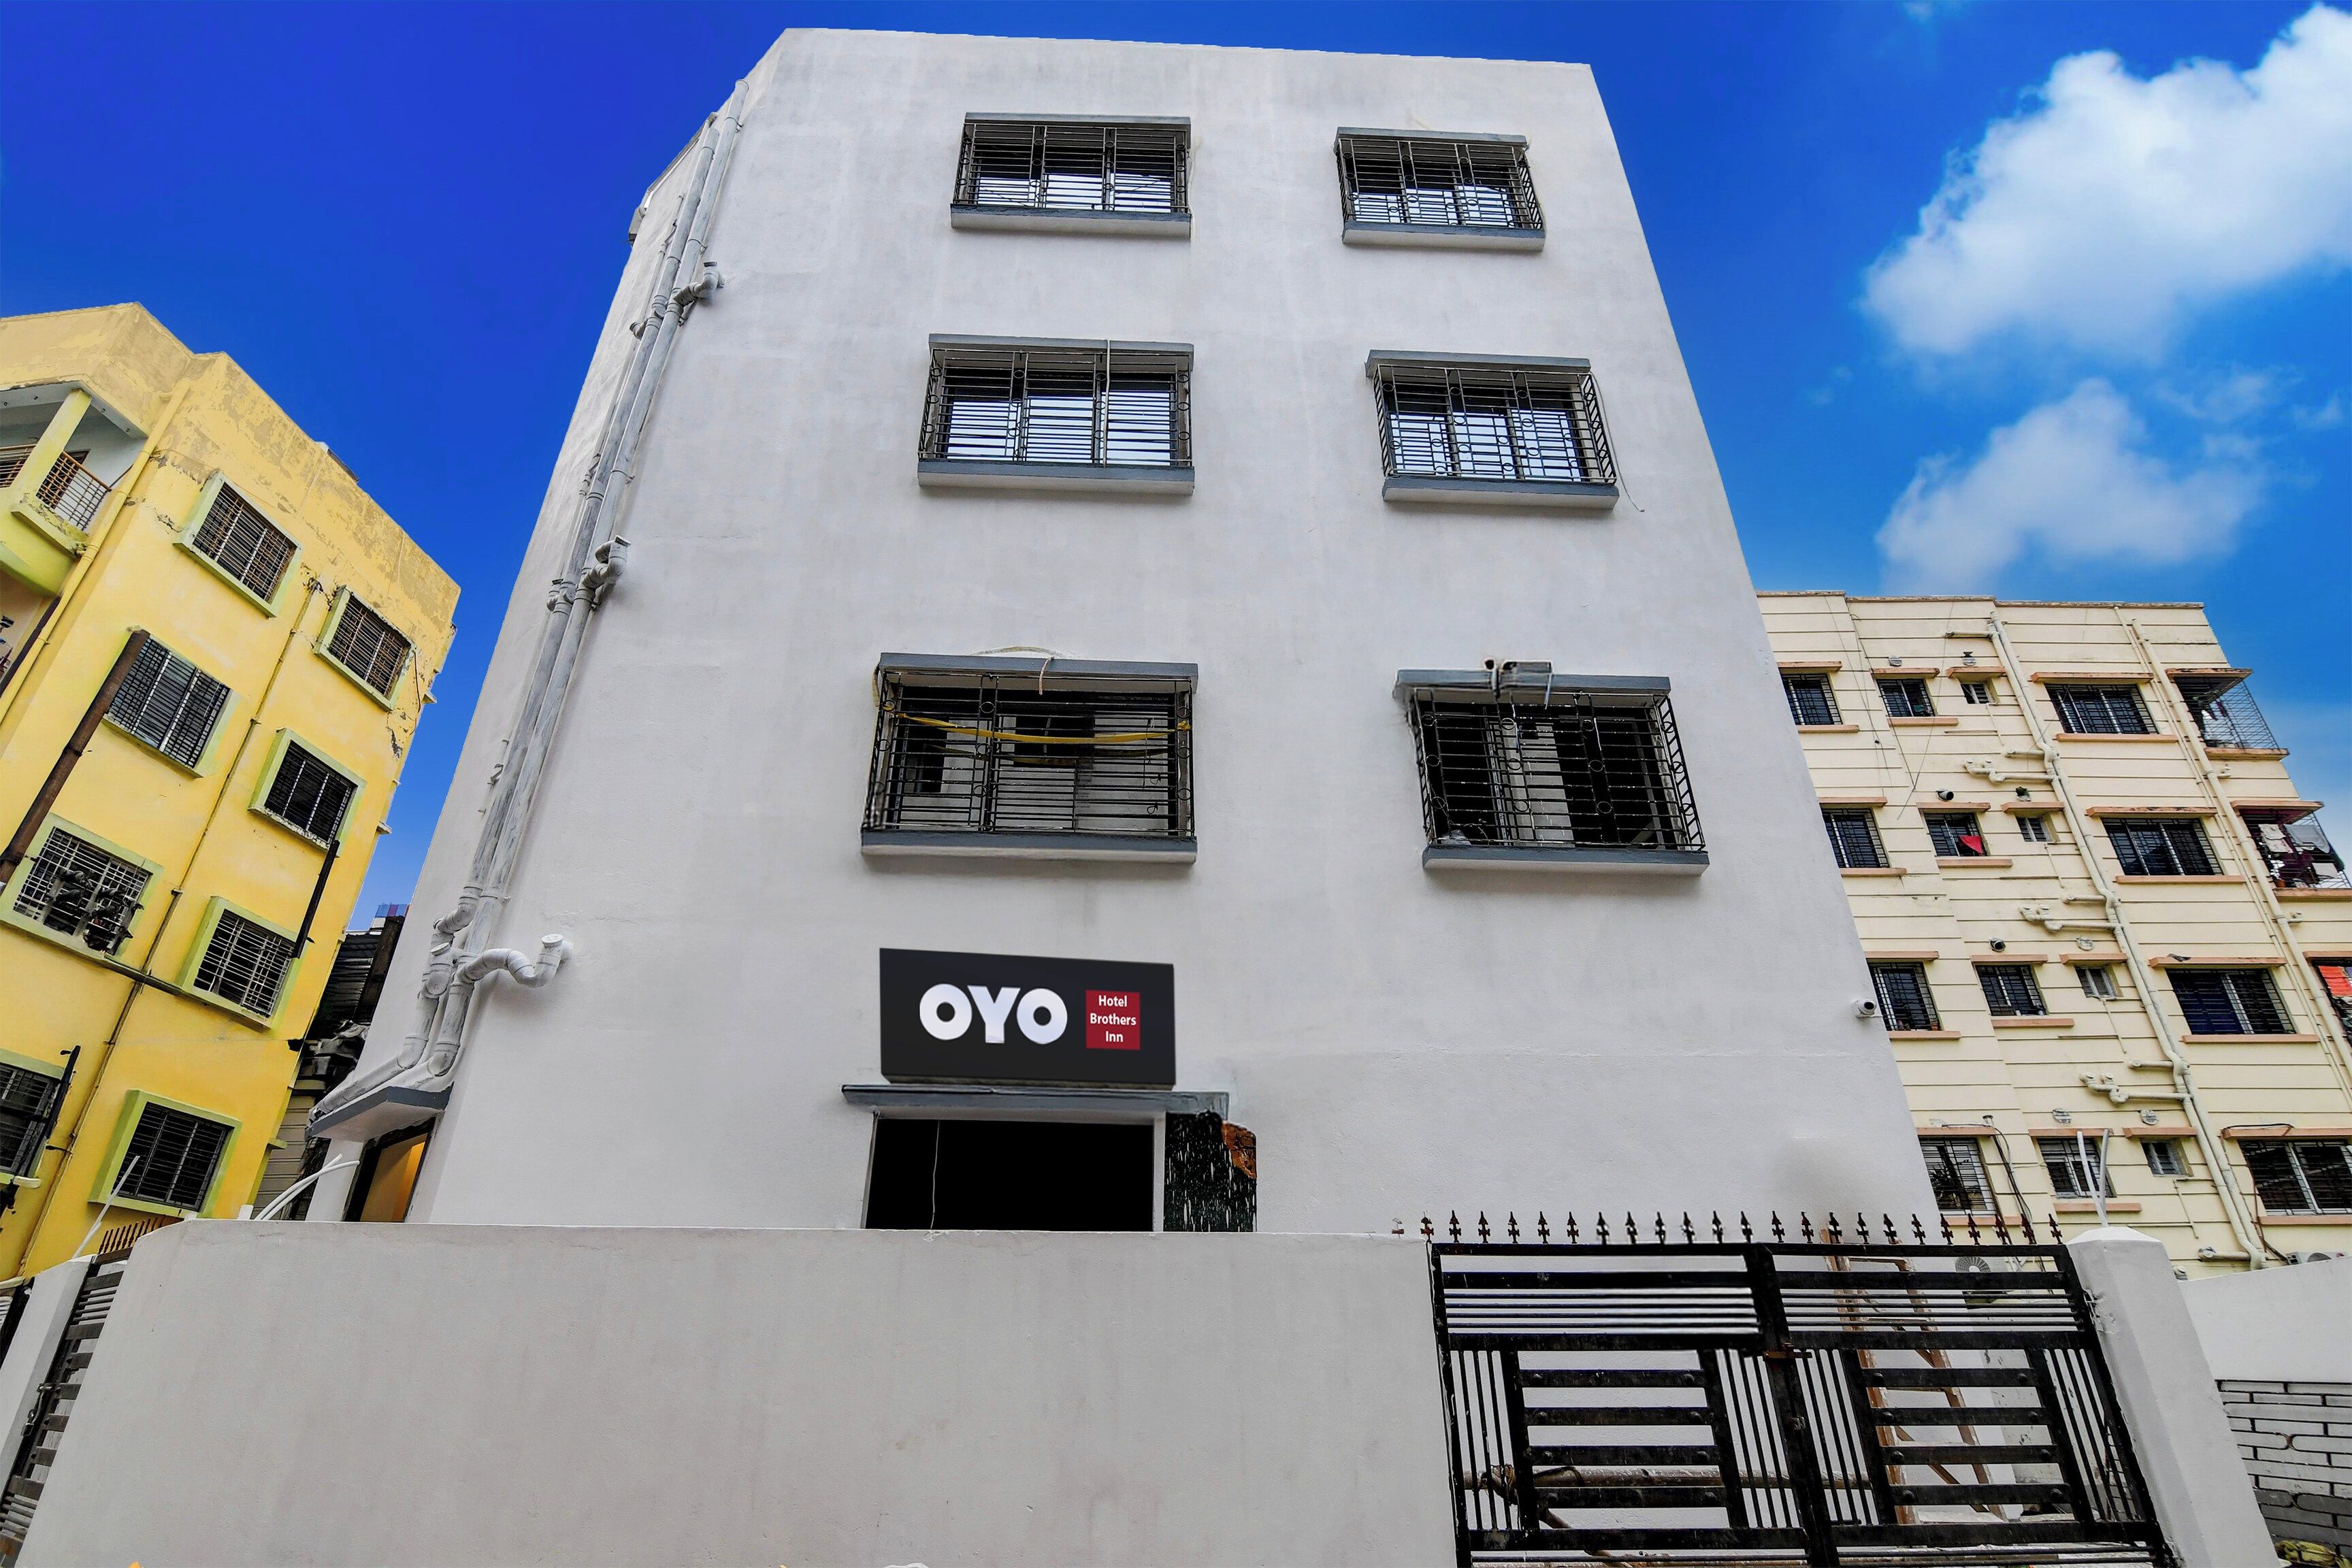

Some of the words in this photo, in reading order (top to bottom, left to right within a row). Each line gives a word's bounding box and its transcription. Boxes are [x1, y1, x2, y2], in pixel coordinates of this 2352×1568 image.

[1098, 995, 1128, 1007] Hotel
[919, 983, 1068, 1045] OYO
[1090, 1013, 1137, 1026] Brothers
[1105, 1030, 1124, 1043] Inn
